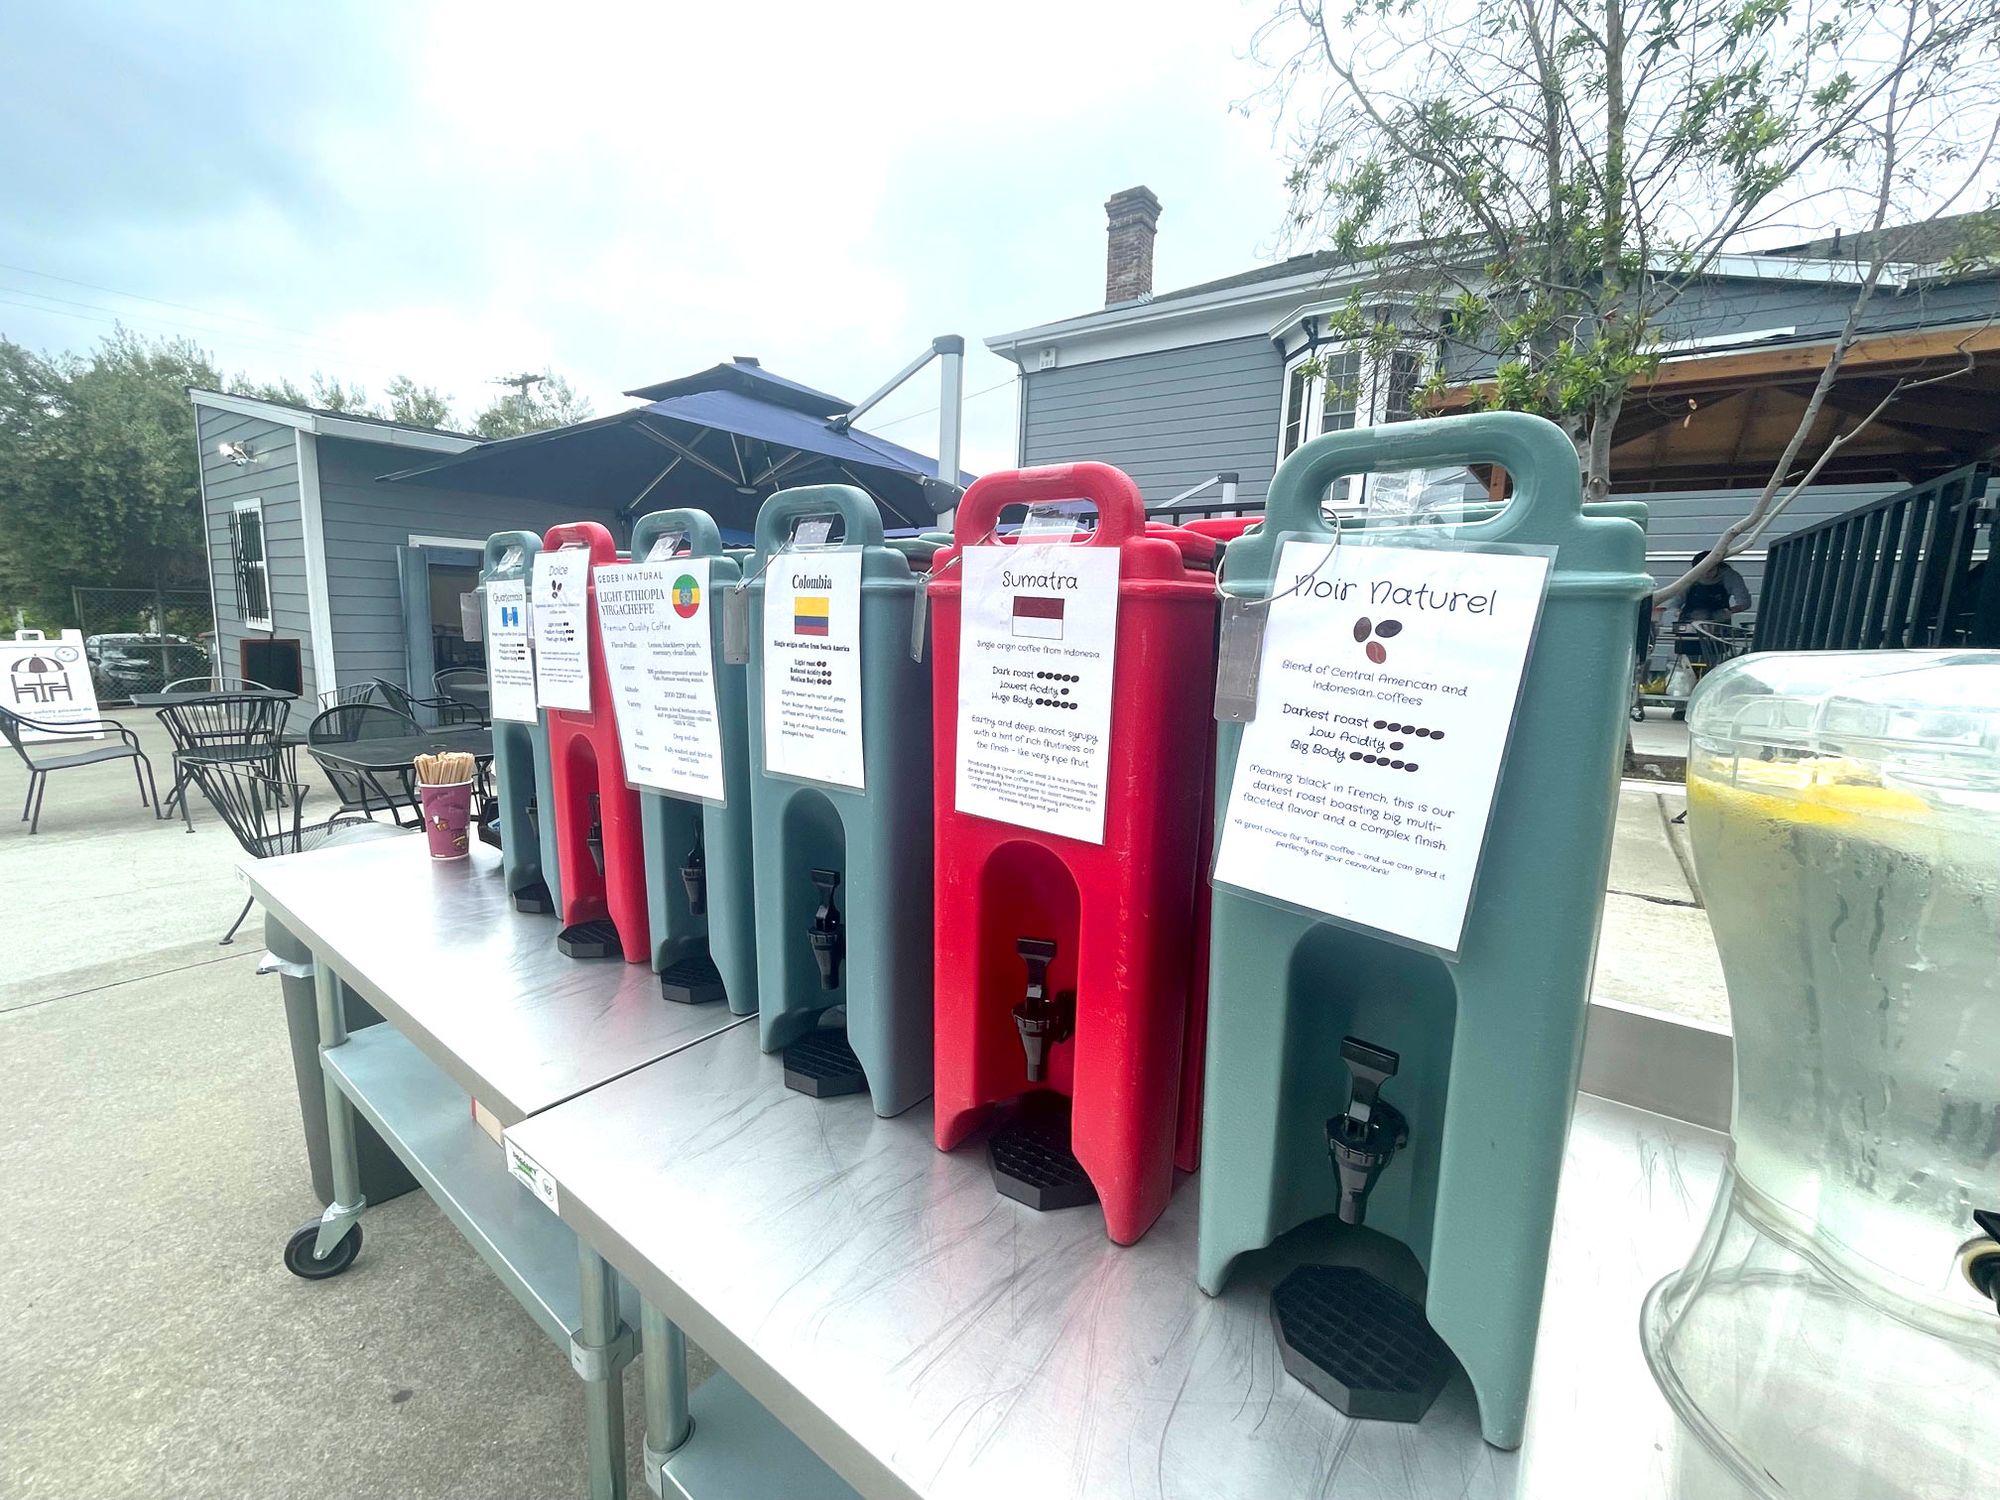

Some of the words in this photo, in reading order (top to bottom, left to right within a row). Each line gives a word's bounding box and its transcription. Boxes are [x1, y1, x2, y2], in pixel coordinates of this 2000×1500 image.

[627, 572, 663, 581] NATURAL
[792, 574, 832, 590] Colombia
[1002, 571, 1078, 590] Sumatra
[628, 622, 649, 633] Quality
[651, 622, 671, 631] Coffee
[977, 640, 995, 651] Single
[997, 643, 1016, 653] origin
[1017, 644, 1041, 653] coffee
[1043, 646, 1061, 654] from
[1064, 649, 1100, 658] Indonesia
[993, 666, 1010, 676] Dark
[1013, 670, 1034, 679] roast
[1282, 660, 1313, 673] Blend
[1316, 665, 1330, 675] of
[1331, 667, 1374, 682] Central
[1378, 674, 1438, 691] American
[1442, 685, 1468, 697] and
[992, 692, 1010, 704] Huge
[1013, 695, 1034, 708] Body
[1000, 680, 1027, 691] Lowest
[1030, 684, 1059, 699] Acidity
[1313, 681, 1374, 698] Indonesian
[1377, 692, 1423, 706] coffees
[972, 715, 996, 729] Earthy
[998, 720, 1013, 728] and
[1014, 722, 1036, 733] deep,
[1038, 726, 1065, 736] almost
[1283, 703, 1329, 722] Darkest
[1334, 715, 1369, 729] roast
[974, 729, 990, 737] with
[1000, 733, 1013, 741] hint
[1015, 735, 1025, 743] of
[1026, 738, 1041, 746] rich
[1043, 739, 1081, 753] fruitiness
[1291, 740, 1309, 755] Big
[1312, 744, 1346, 764] Body
[1309, 726, 1336, 739] Low
[1340, 732, 1386, 754] Acidity
[977, 741, 988, 749] the
[991, 743, 1009, 753] finish
[1018, 748, 1030, 757] like
[1032, 752, 1050, 764] very
[1052, 756, 1068, 765] ripe
[1250, 764, 1293, 784] Meaning
[1348, 786, 1388, 804] French,
[1394, 796, 1414, 810] this
[1418, 804, 1428, 812] is
[1432, 807, 1455, 818] our
[1244, 792, 1284, 811] faceted
[1288, 803, 1320, 818] flavor
[1323, 814, 1346, 826] and
[1361, 823, 1410, 842] complex
[1253, 780, 1292, 797] darkest
[1296, 792, 1326, 805] roast
[1330, 798, 1380, 821] boasting
[1407, 818, 1442, 832] multi-
